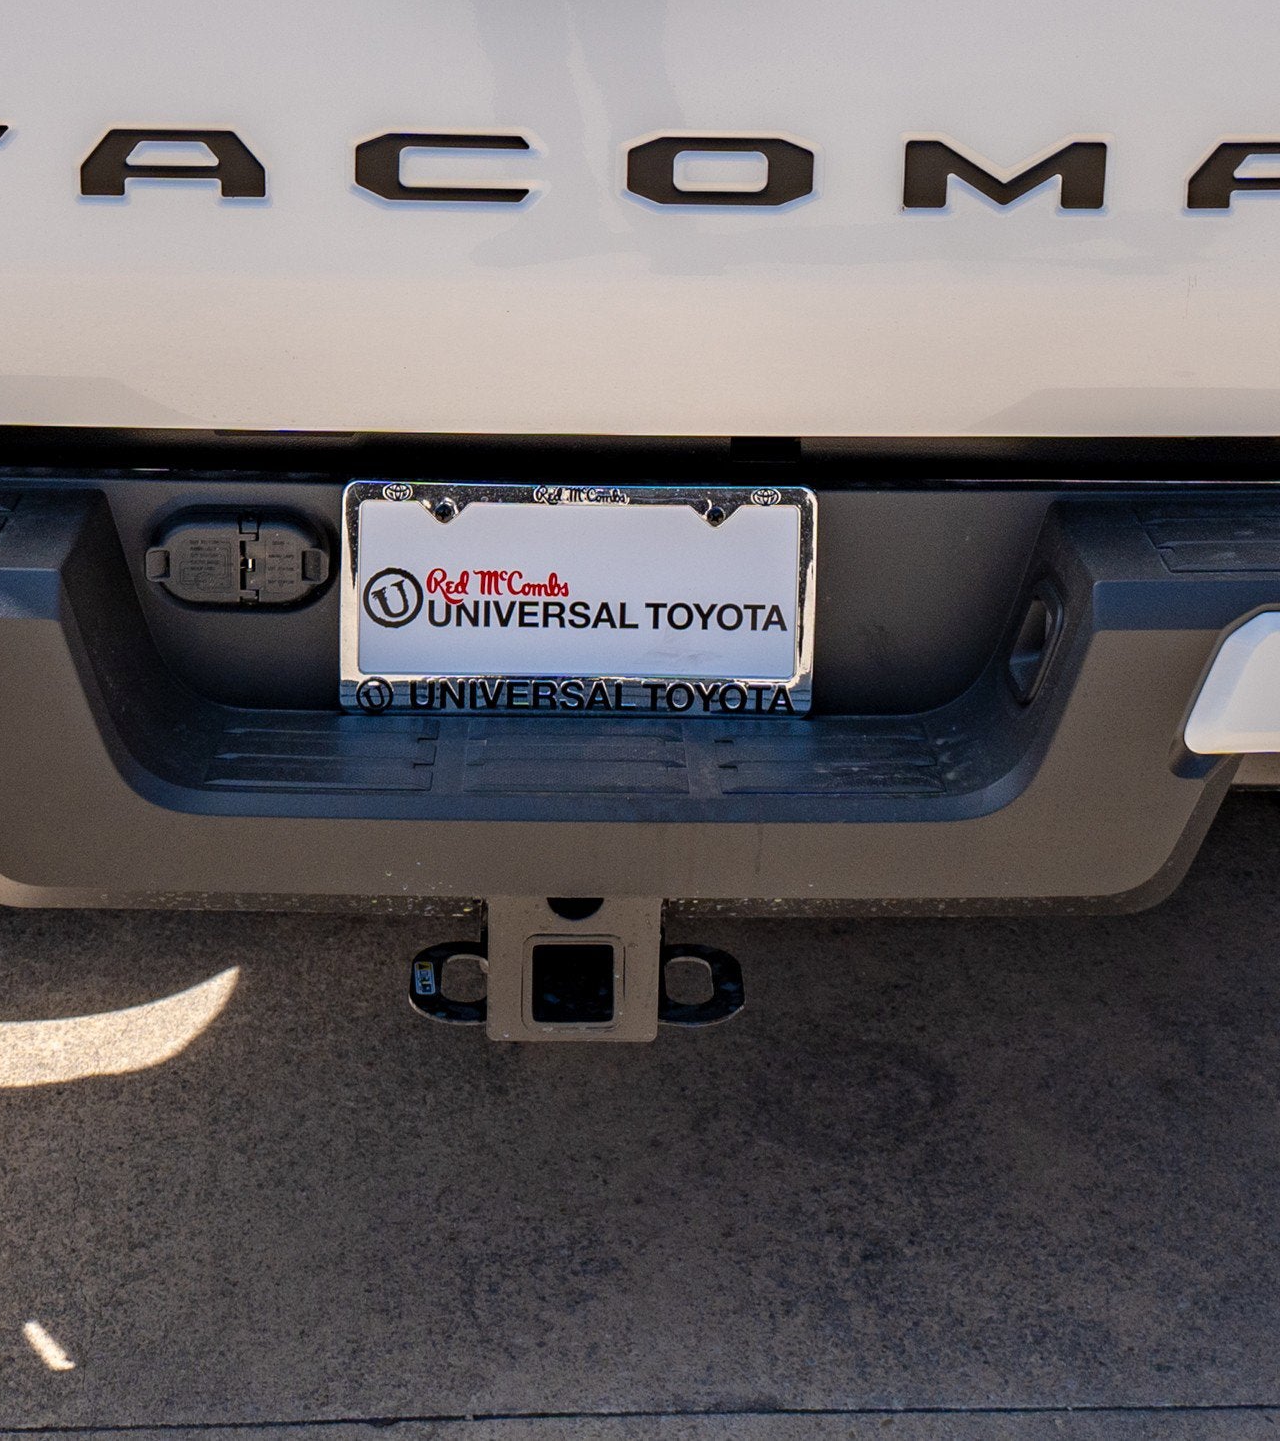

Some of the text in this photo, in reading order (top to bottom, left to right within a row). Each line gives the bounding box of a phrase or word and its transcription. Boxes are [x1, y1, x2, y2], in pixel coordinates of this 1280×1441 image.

[534, 485, 563, 505] Red
[426, 568, 570, 605] Red McCombs
[427, 599, 788, 632] UNIVERSAL TOYOTA
[408, 680, 637, 711] UNIVERSAL
[643, 682, 797, 714] TOYOTA
